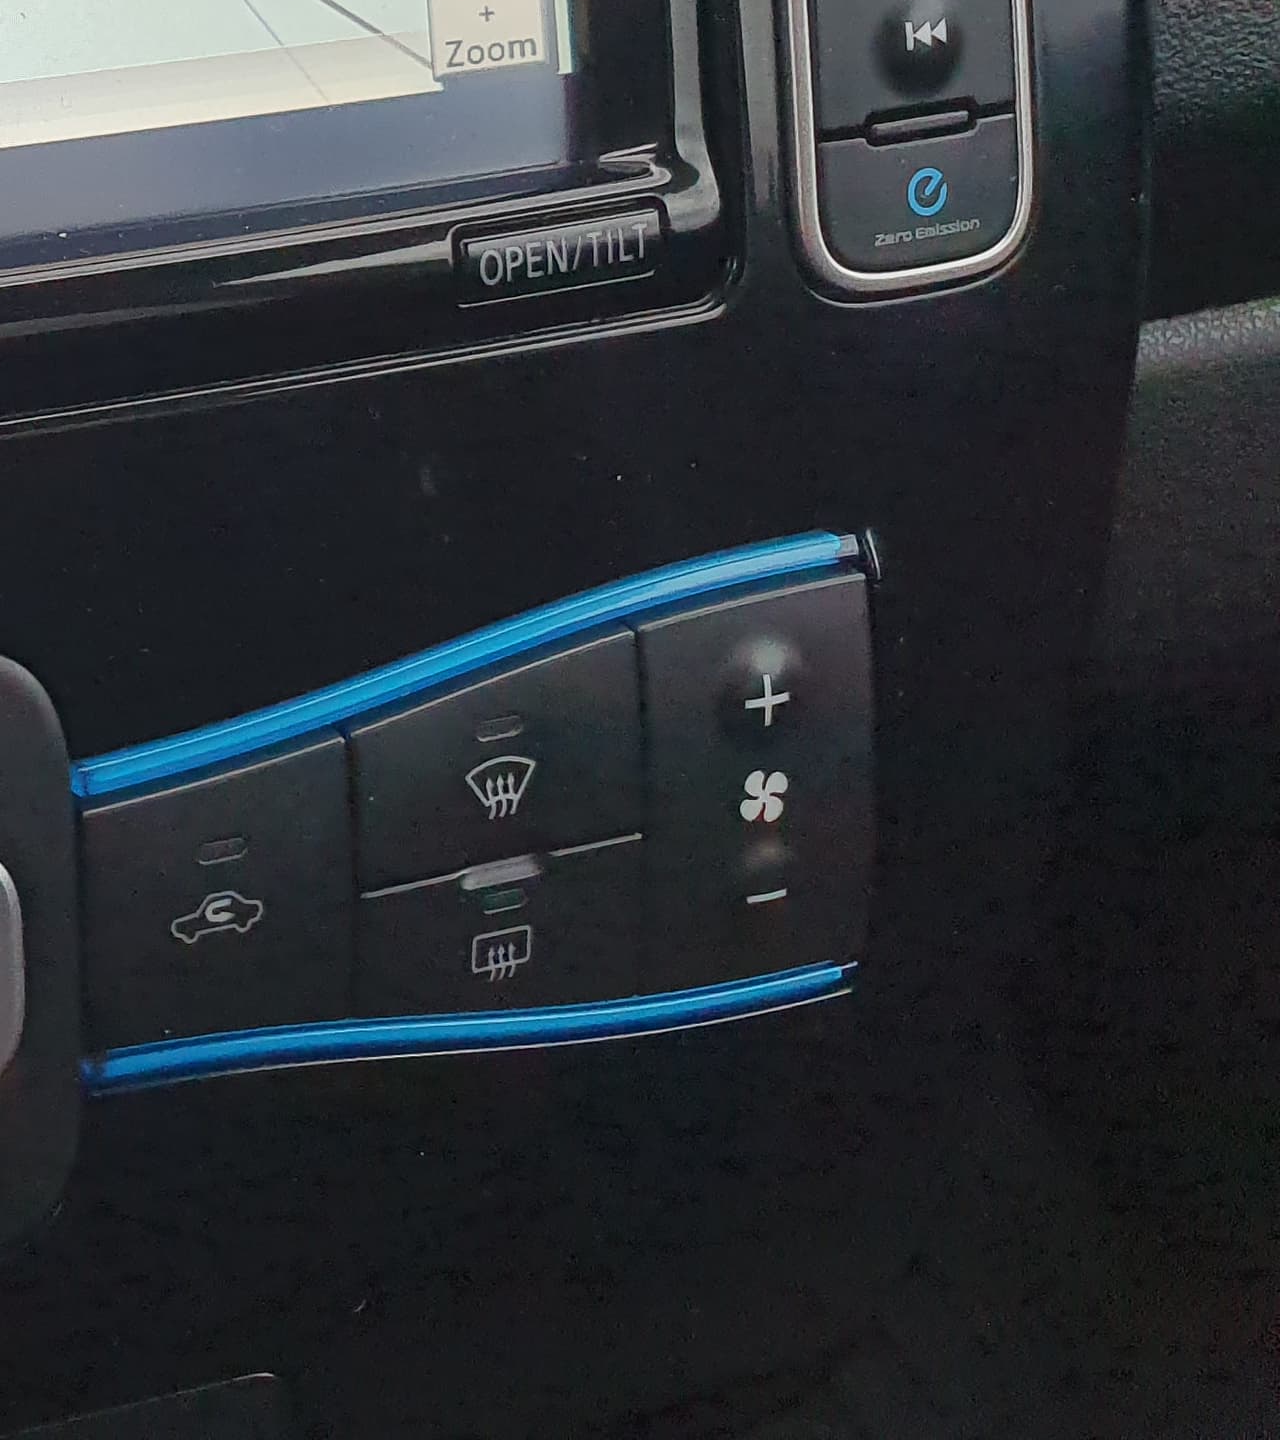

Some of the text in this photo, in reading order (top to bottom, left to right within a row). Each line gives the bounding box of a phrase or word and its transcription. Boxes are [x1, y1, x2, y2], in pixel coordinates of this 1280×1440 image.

[444, 34, 538, 69] Zoom
[874, 218, 981, 247] Zero Emission
[477, 224, 650, 288] OPEN/TILT
